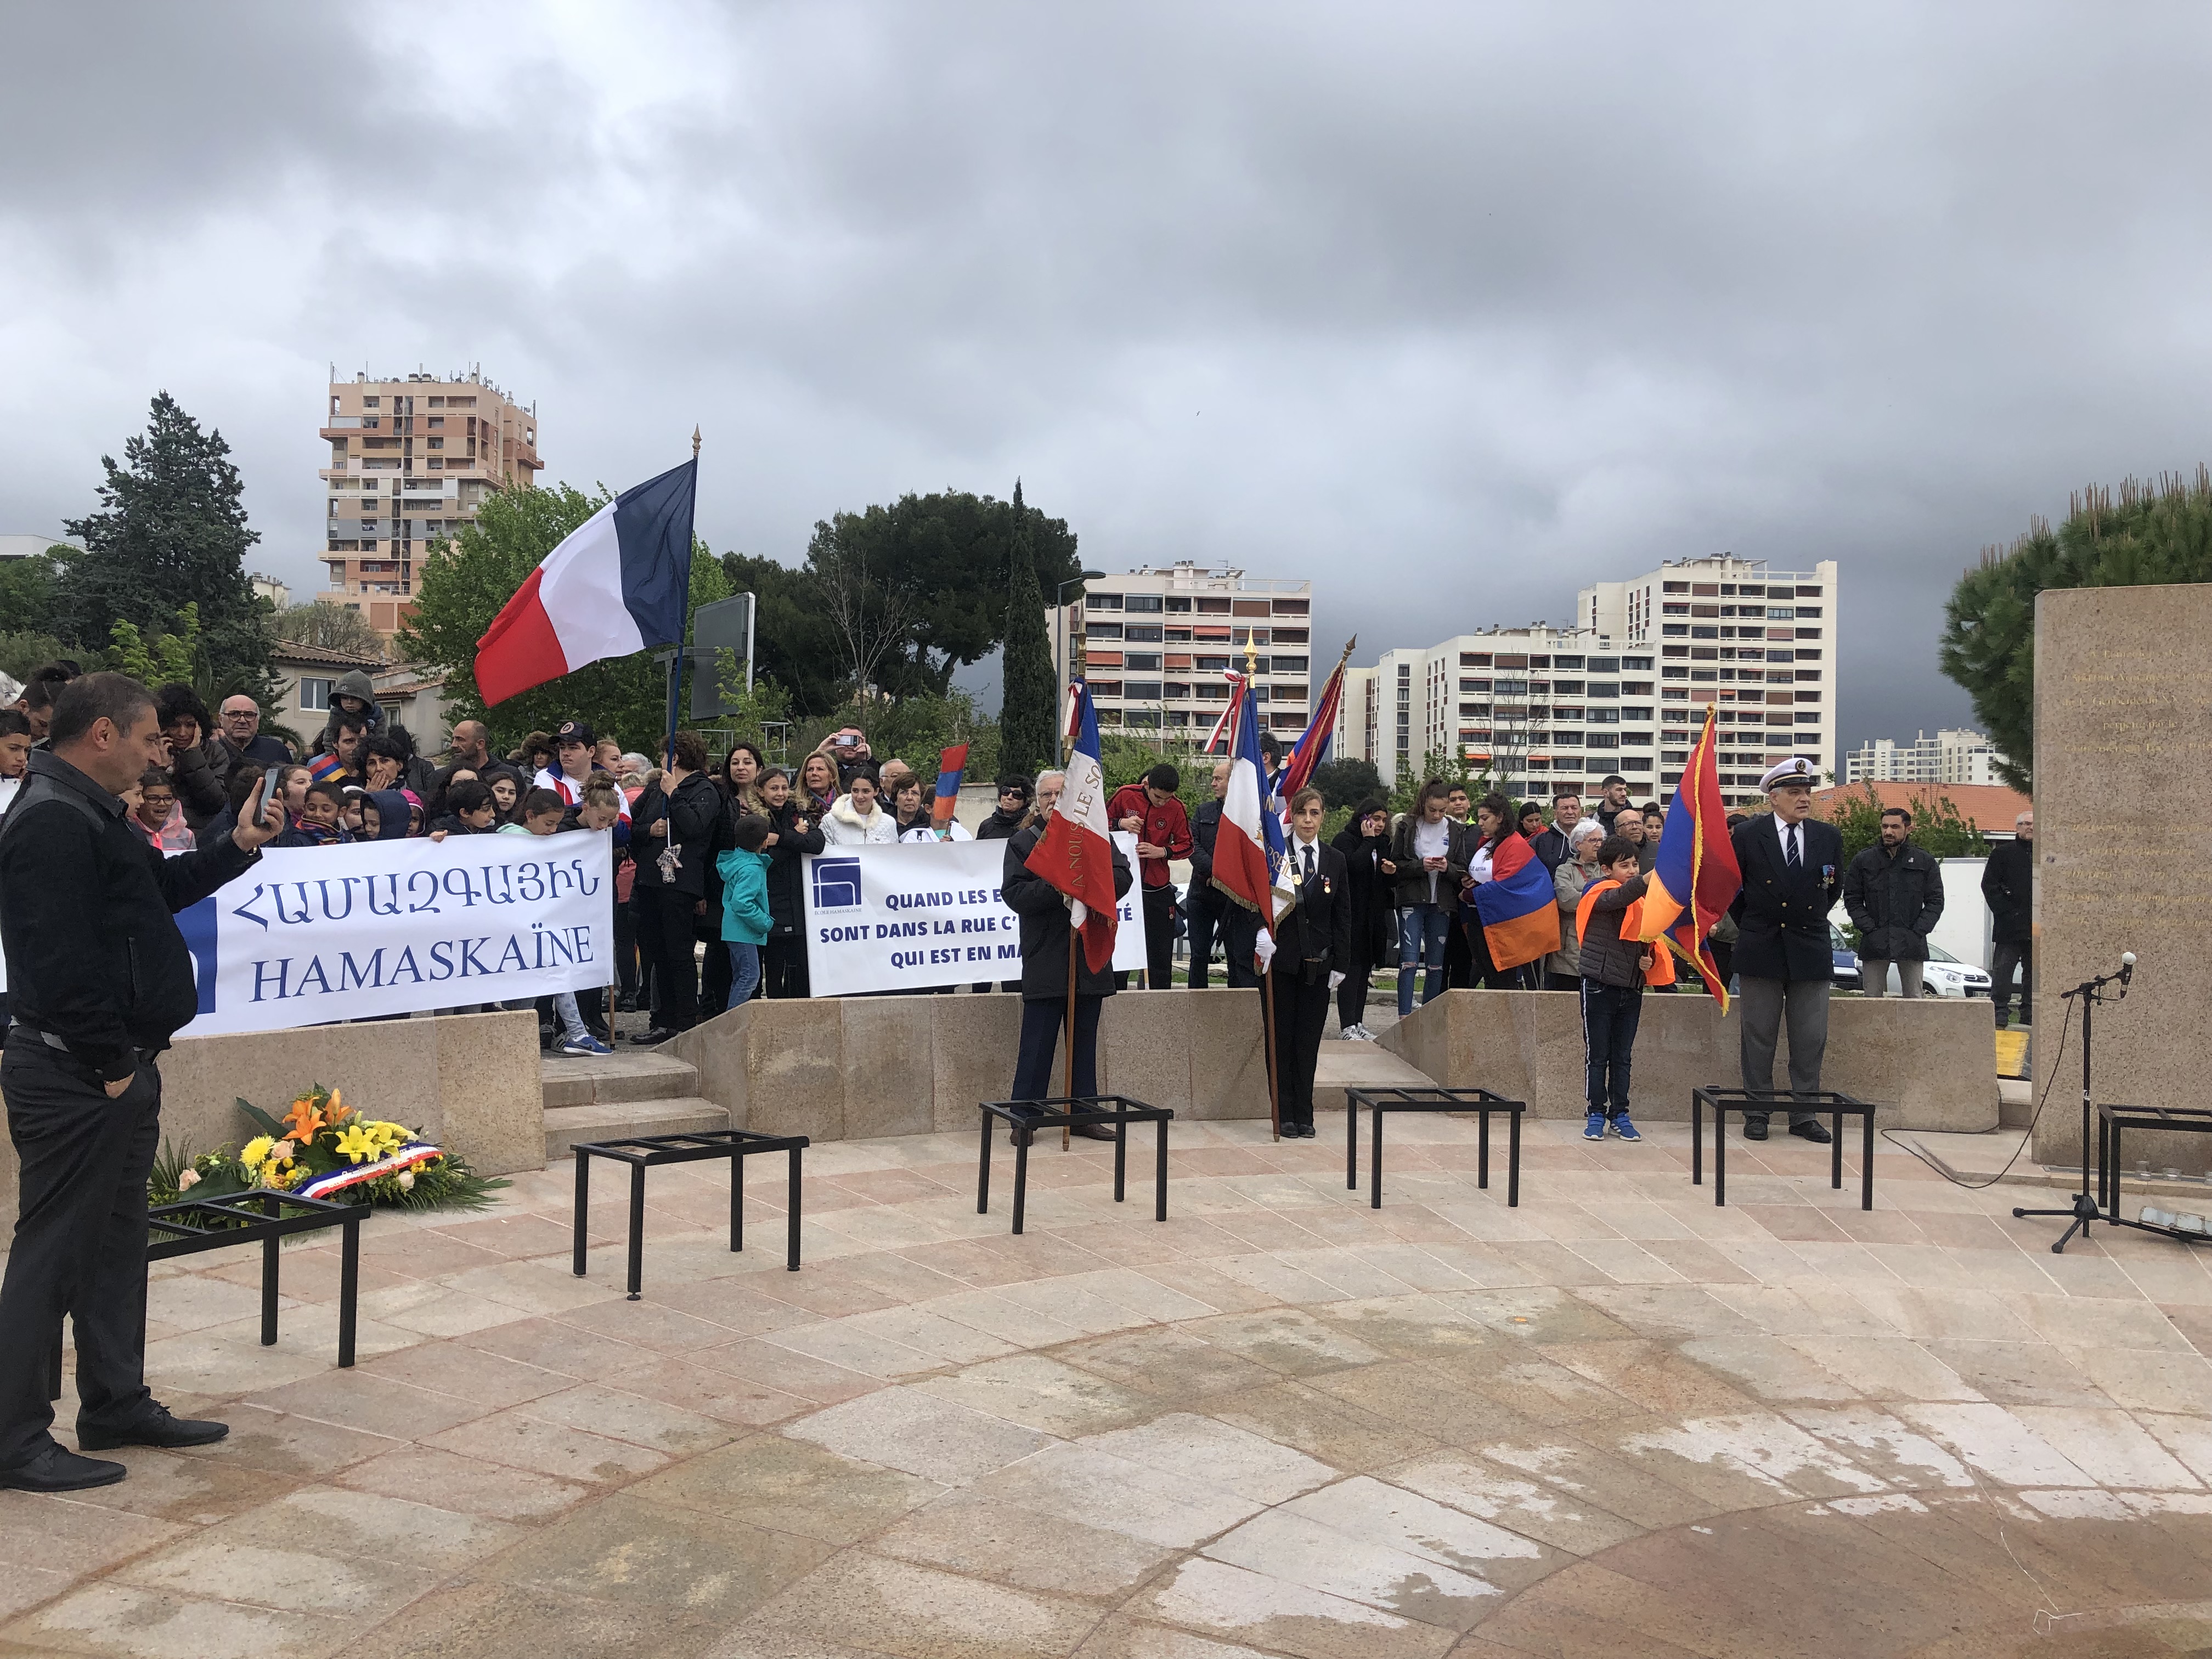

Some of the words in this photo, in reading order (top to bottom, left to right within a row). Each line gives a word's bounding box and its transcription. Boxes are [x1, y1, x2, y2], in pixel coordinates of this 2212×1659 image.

[1073, 792, 1093, 817] LE
[1068, 821, 1085, 871] NOUS
[885, 892, 953, 911] QUAND
[958, 889, 988, 905] LES
[992, 889, 1002, 902] E
[820, 926, 870, 943] SONT
[876, 922, 928, 939] DANS
[934, 920, 956, 935] LA
[961, 917, 996, 933] RUE
[249, 922, 592, 1002] HAMASKAÏNE
[891, 951, 924, 969] QUI
[930, 949, 961, 964] EST
[967, 946, 991, 961] EN
